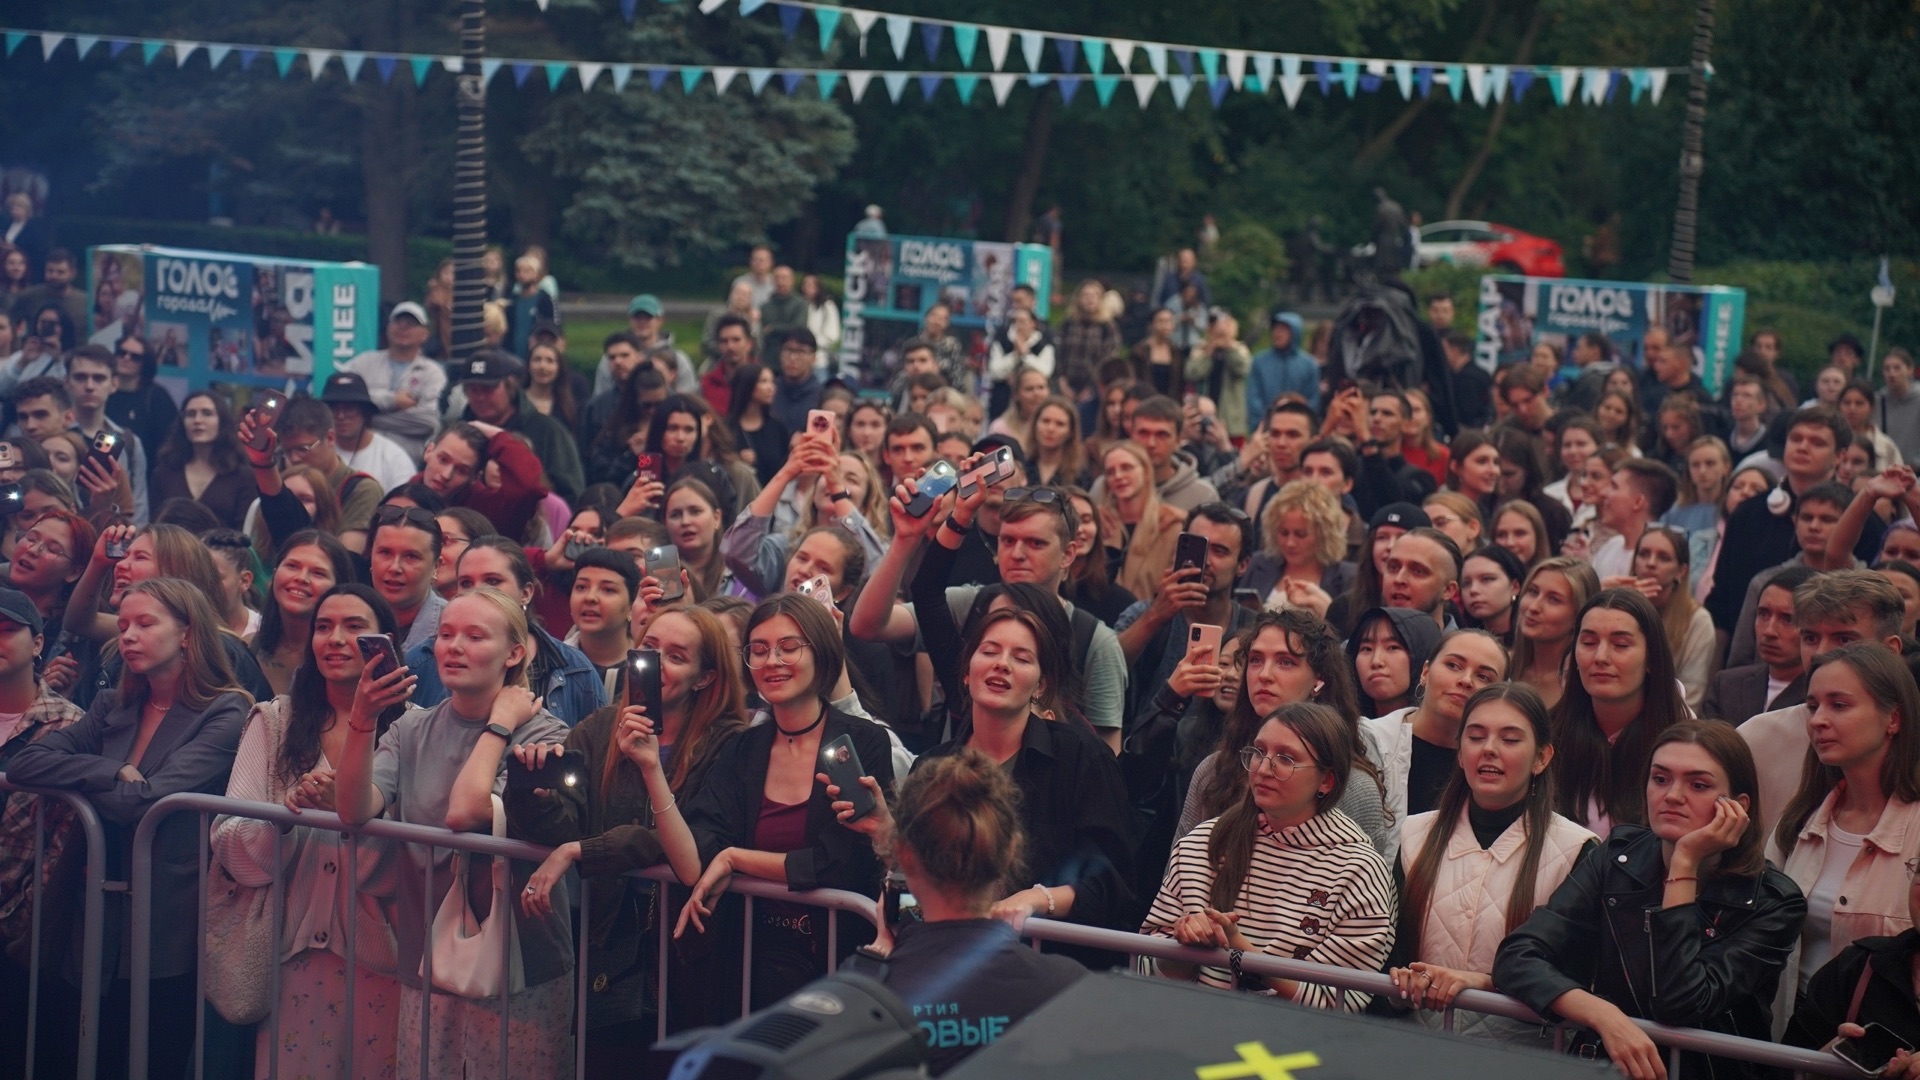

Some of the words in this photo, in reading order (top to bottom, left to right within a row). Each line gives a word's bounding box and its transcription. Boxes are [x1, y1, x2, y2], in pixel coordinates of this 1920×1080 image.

[900, 241, 964, 268] ГОЛОС
[157, 259, 239, 299] ГОЛОС
[1549, 287, 1633, 317] ГОЛОС
